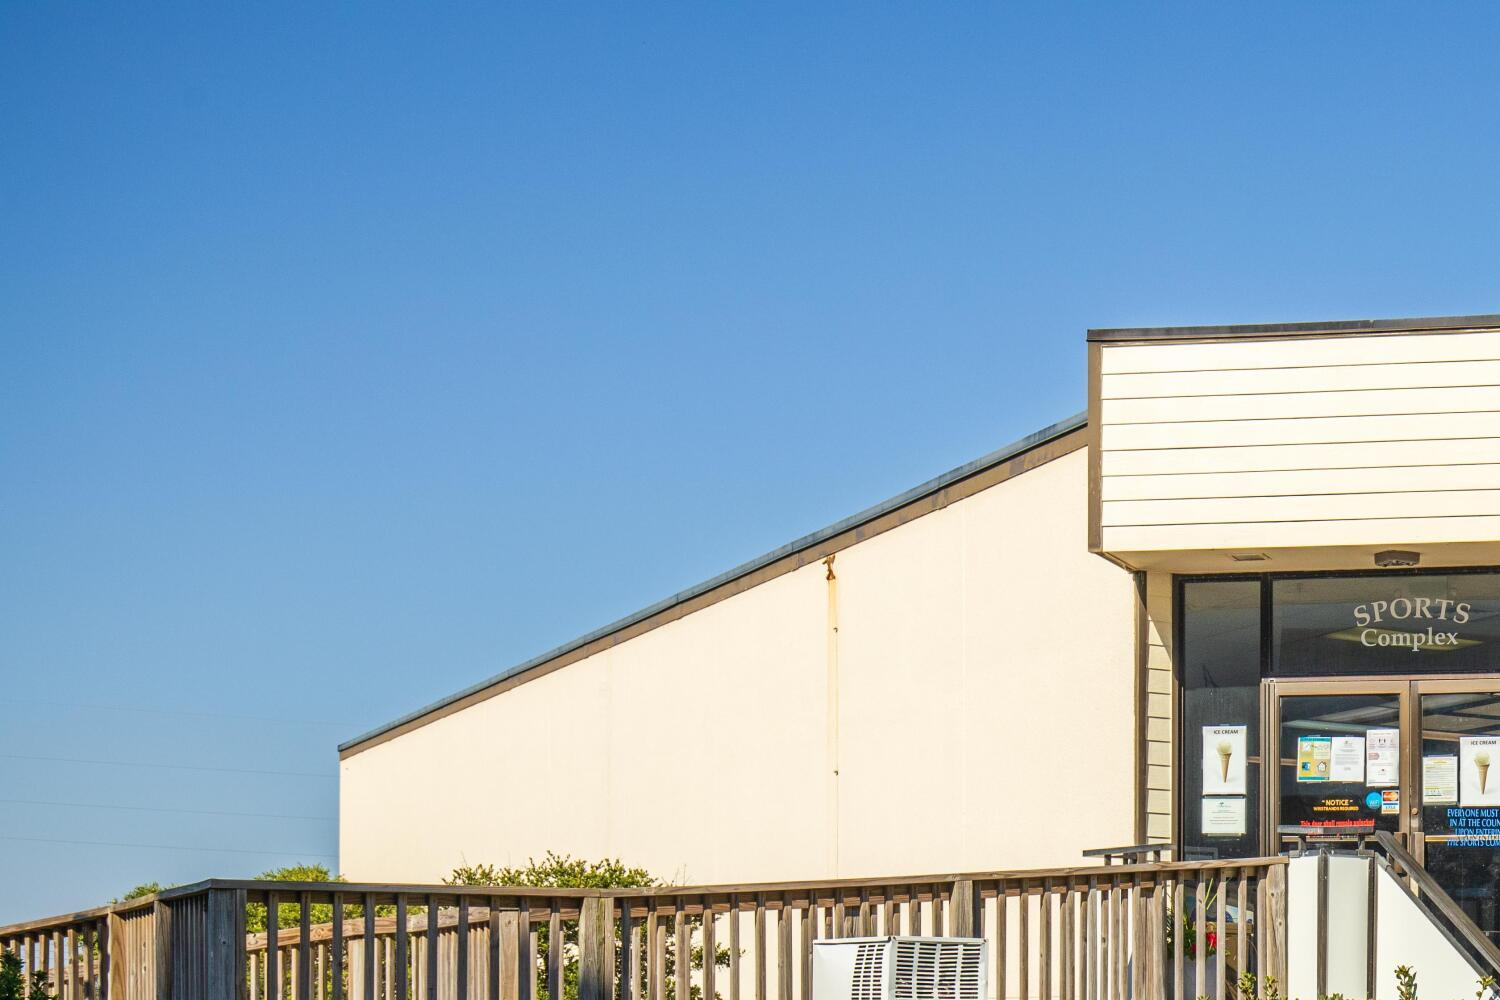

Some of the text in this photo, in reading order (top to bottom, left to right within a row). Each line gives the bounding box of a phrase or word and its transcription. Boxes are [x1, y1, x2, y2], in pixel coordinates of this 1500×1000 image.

[1353, 597, 1471, 627] SPORTS
[1360, 627, 1459, 652] Complex
[1447, 808, 1479, 817] EVERYONE
[1480, 808, 1499, 817] MUST
[1450, 818, 1457, 827] IN
[1458, 818, 1467, 827] AT
[1468, 818, 1481, 827] THE
